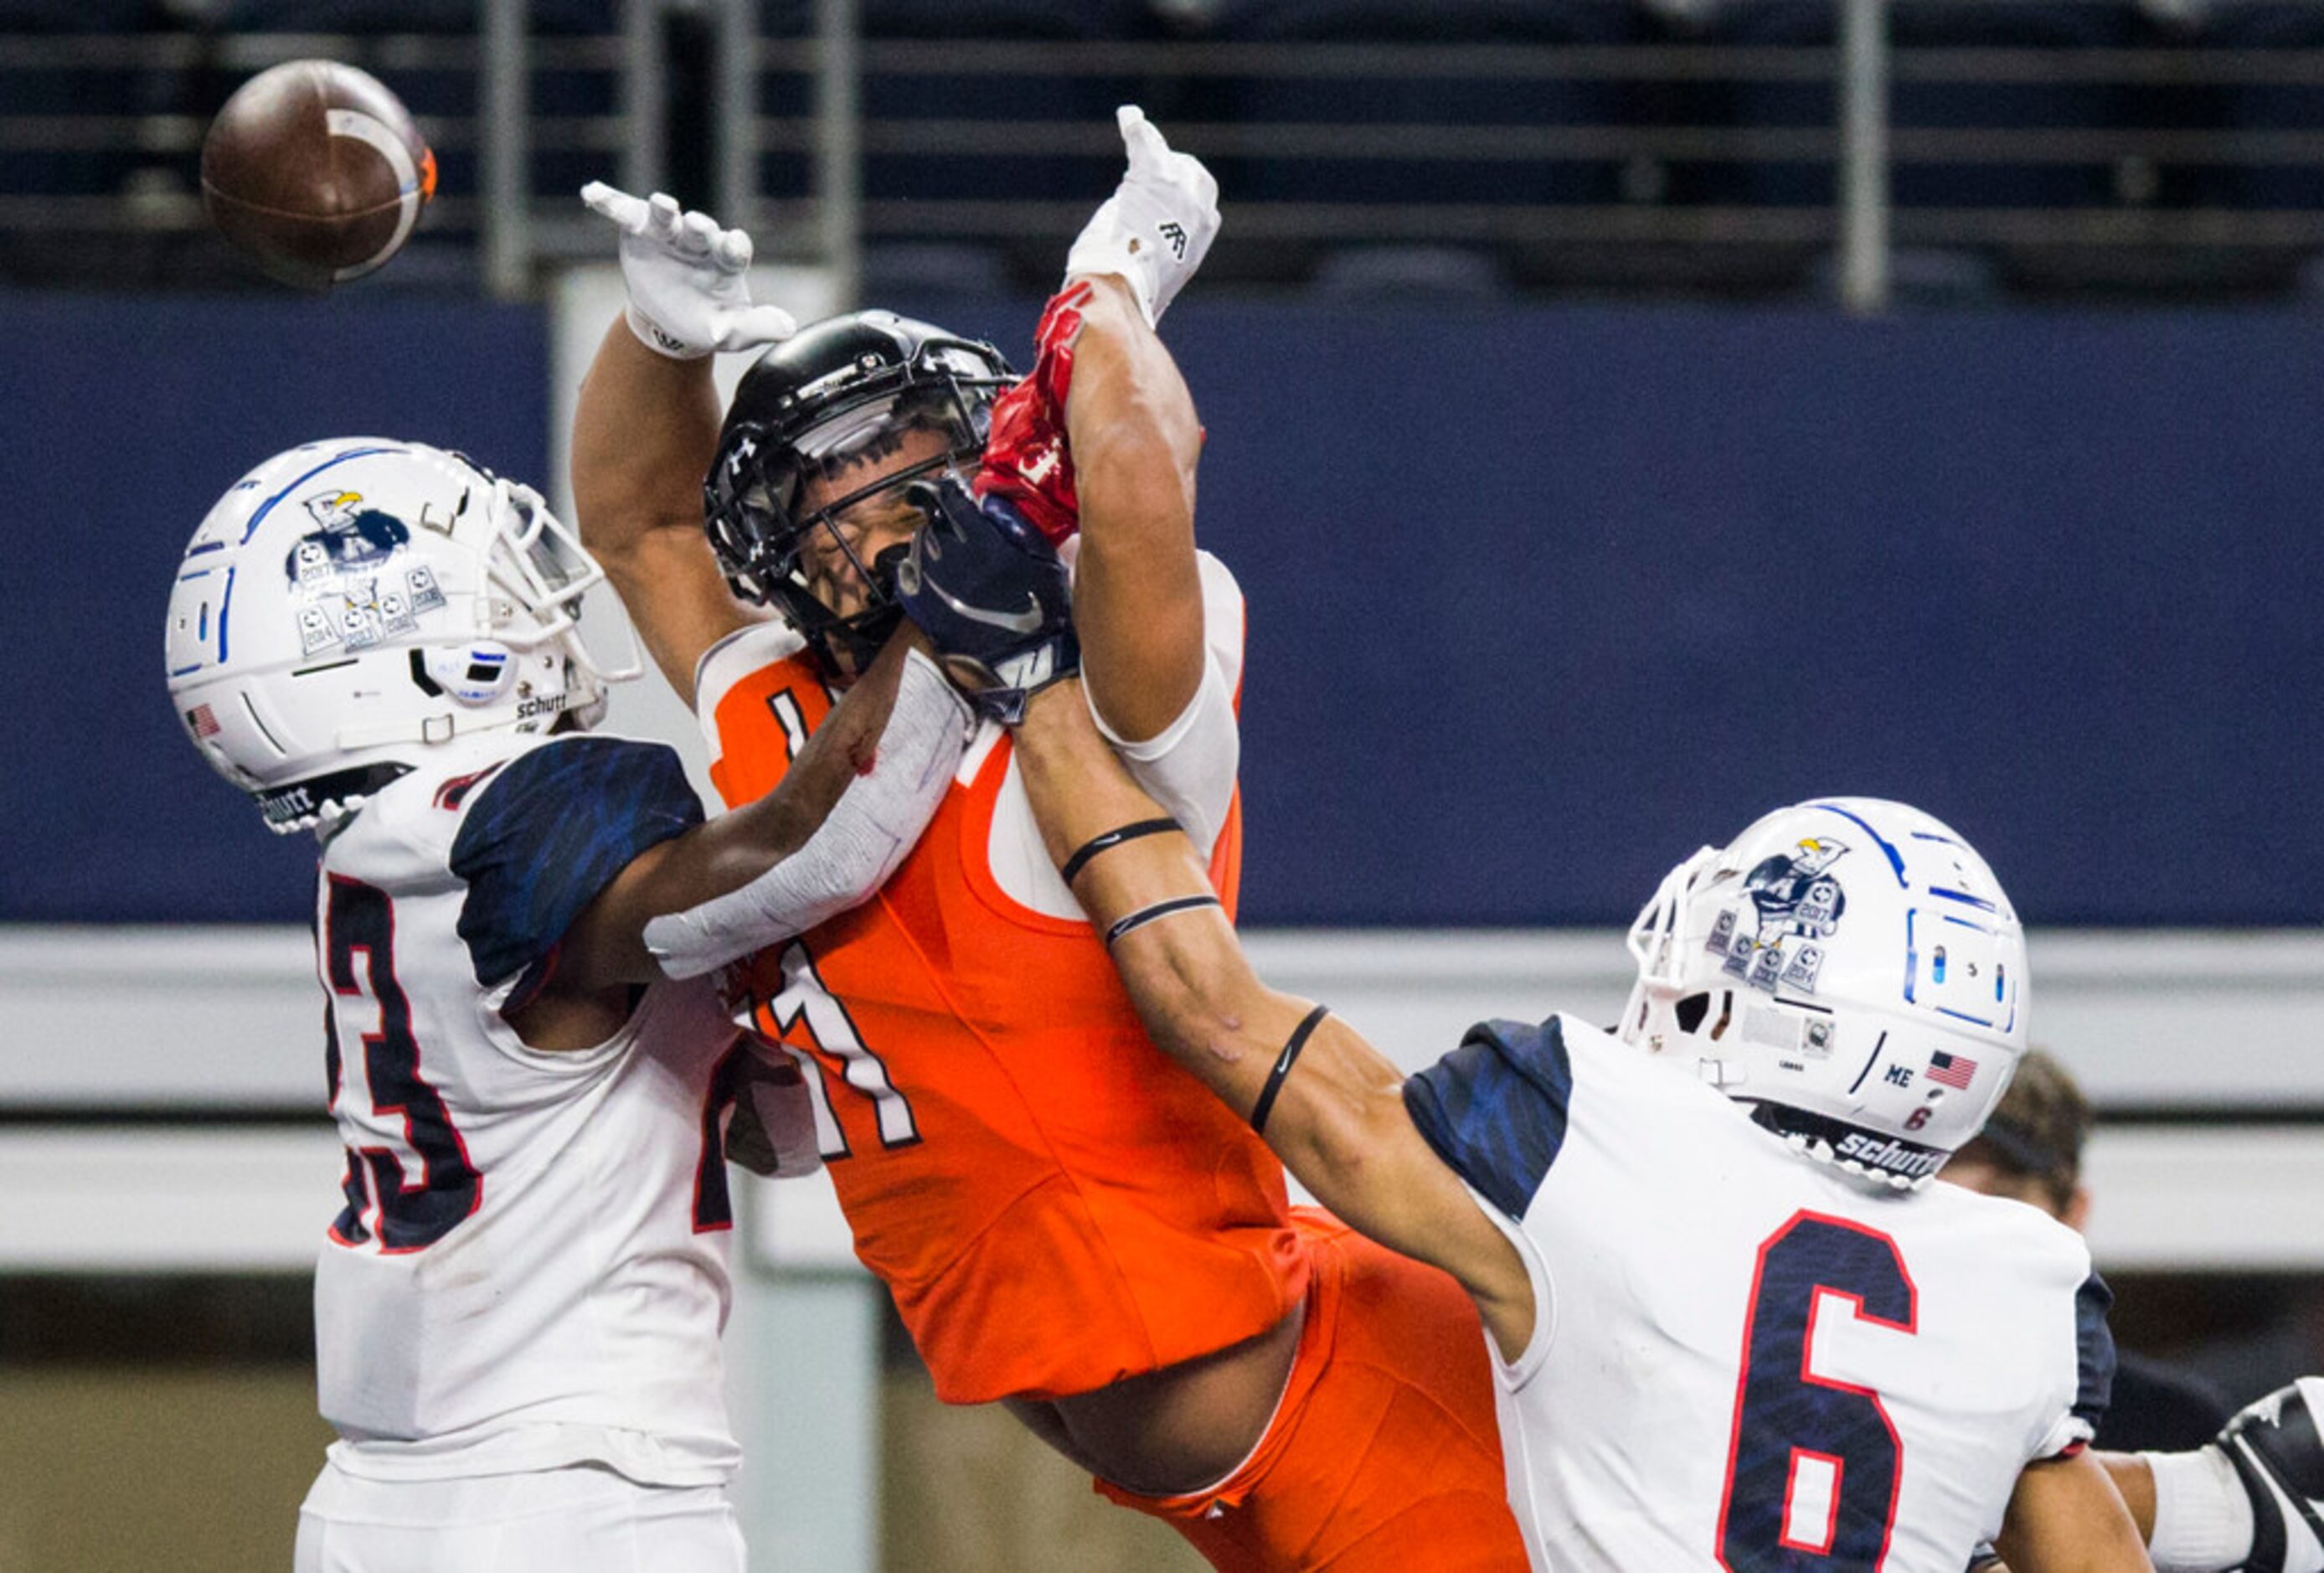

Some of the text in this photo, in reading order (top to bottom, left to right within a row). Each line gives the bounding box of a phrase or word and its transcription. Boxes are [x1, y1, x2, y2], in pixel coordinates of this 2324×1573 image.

[517, 694, 566, 719] schutt
[1800, 902, 1828, 922] 2017
[1884, 1064, 1914, 1088] ME
[1904, 1106, 1933, 1131] 6
[1713, 1208, 1919, 1573] 6
